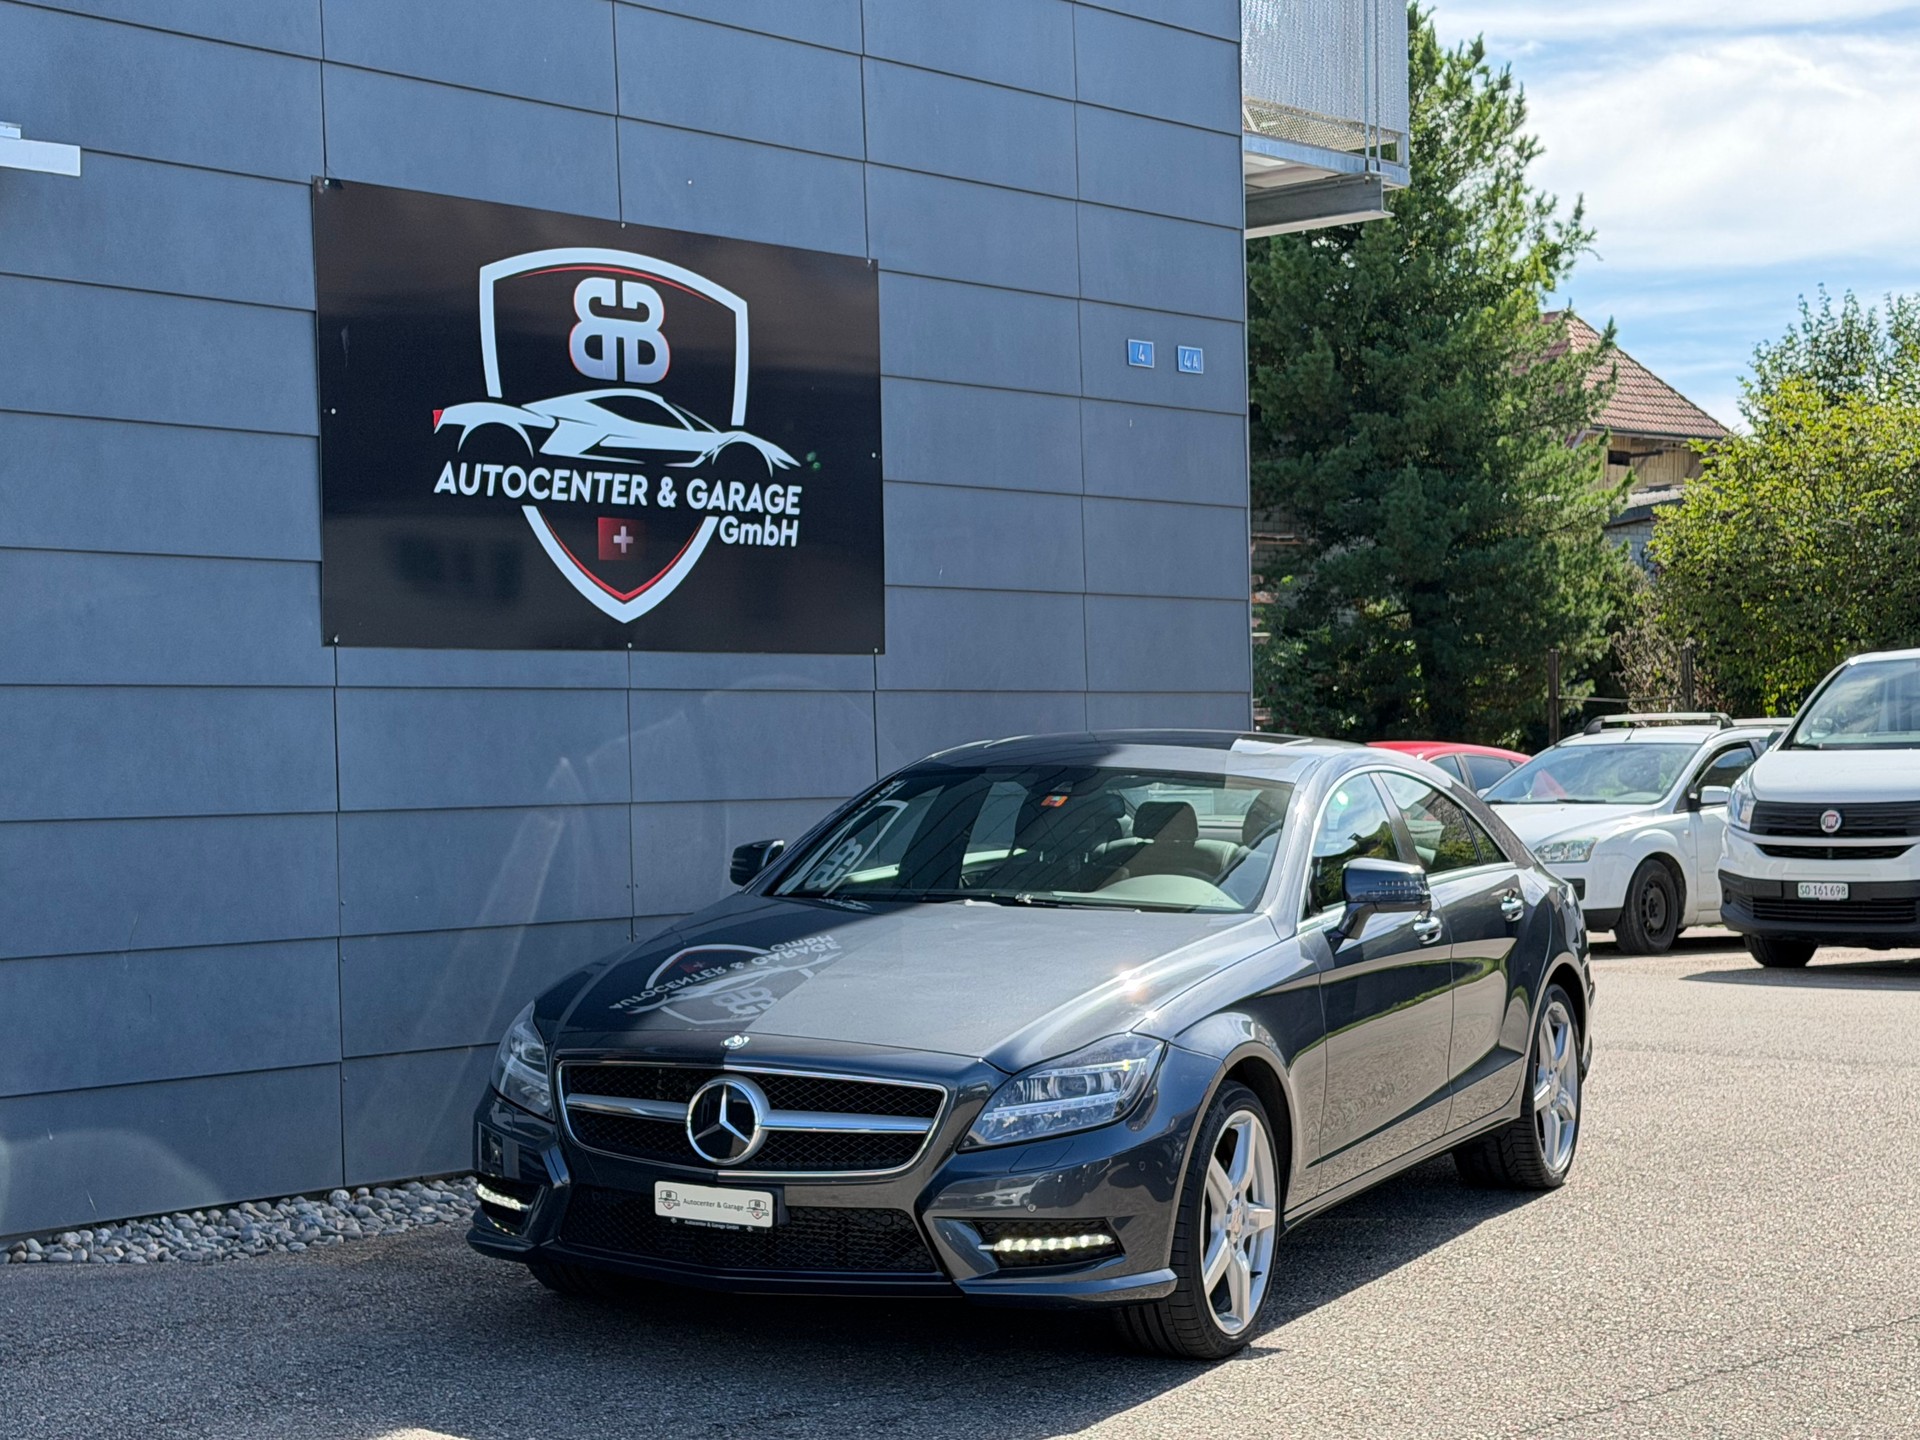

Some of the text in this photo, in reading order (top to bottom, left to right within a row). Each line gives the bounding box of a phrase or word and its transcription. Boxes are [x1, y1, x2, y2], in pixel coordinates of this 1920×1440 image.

[1137, 344, 1145, 362] 4
[434, 461, 802, 515] AUTOCENTER & GARAGE
[719, 515, 799, 547] GmbH
[683, 1198, 715, 1208] Autocenter
[723, 1202, 744, 1212] Garage
